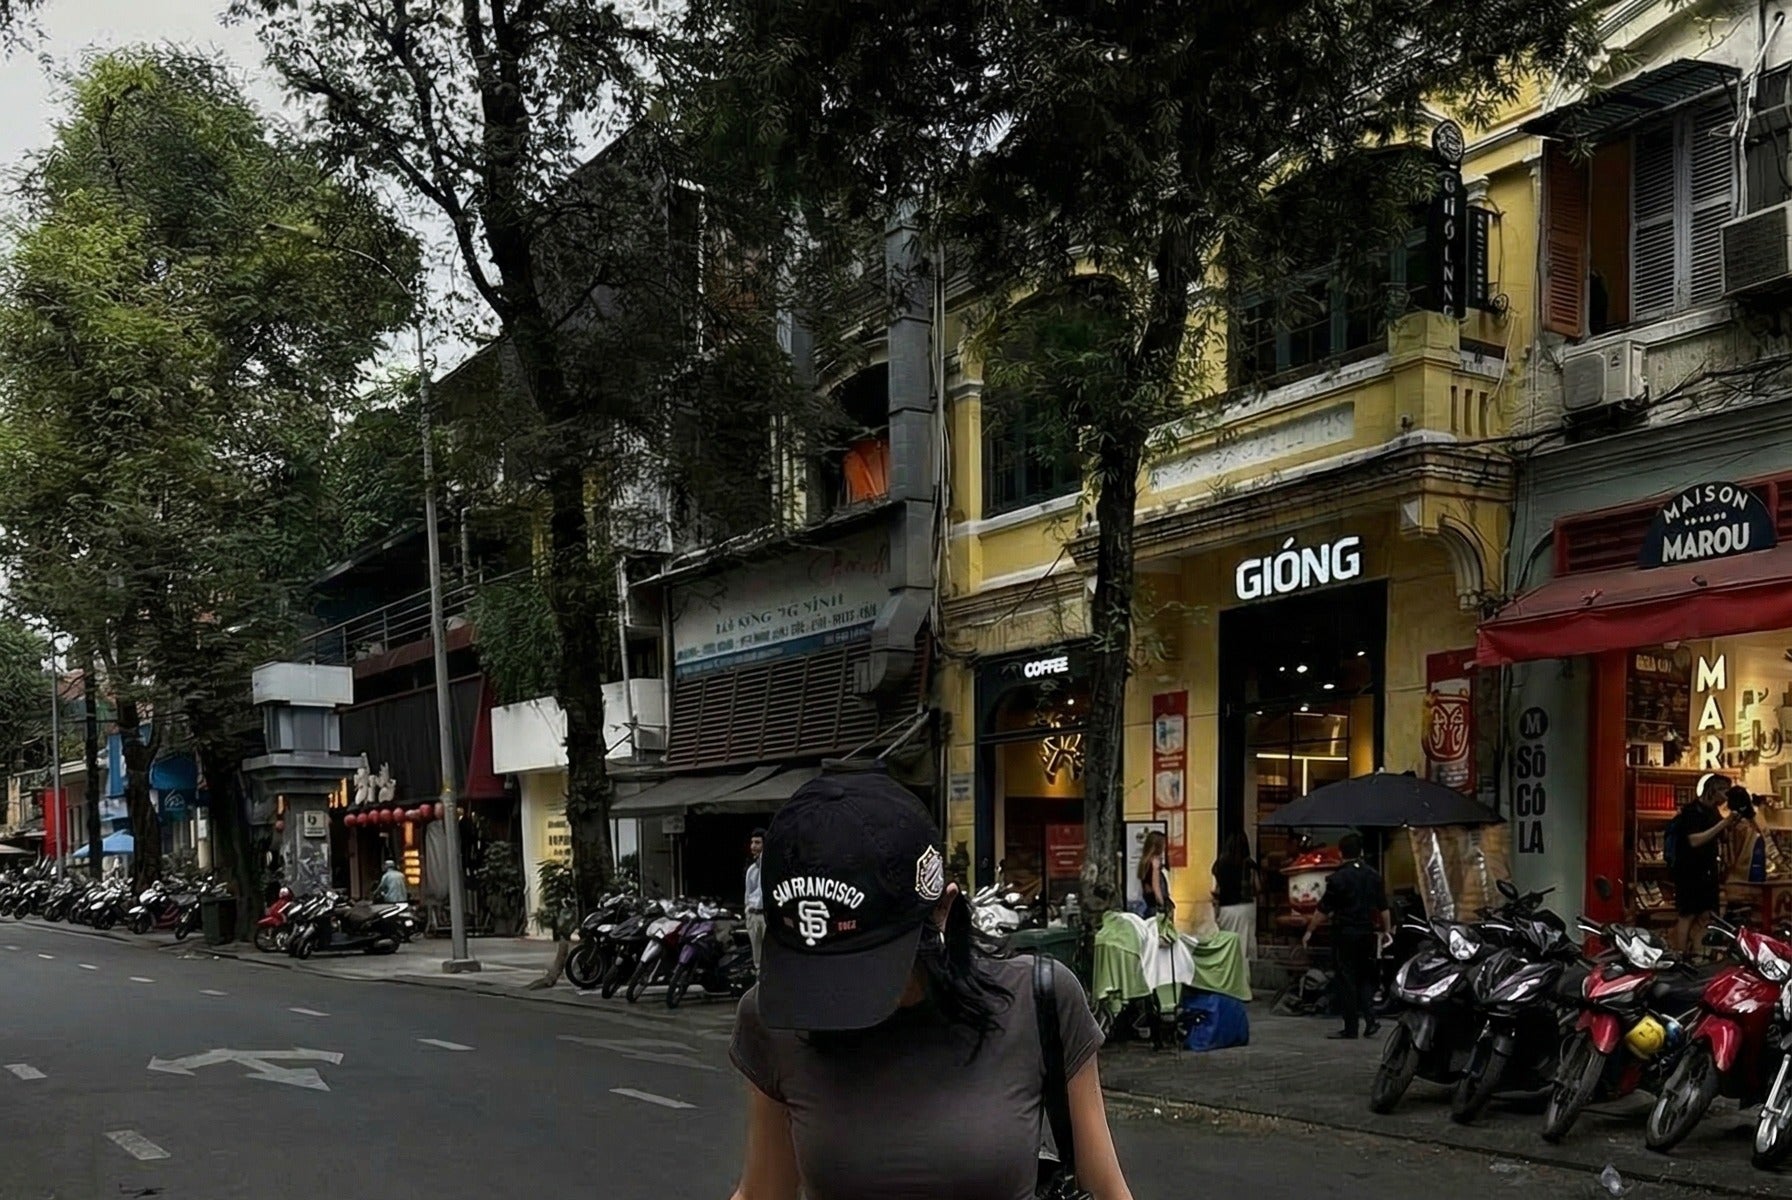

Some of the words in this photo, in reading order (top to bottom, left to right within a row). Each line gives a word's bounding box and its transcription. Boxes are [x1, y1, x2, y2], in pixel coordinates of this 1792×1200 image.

[1663, 485, 1748, 524] MAISON
[1662, 522, 1749, 562] MAROU
[1236, 536, 1360, 600] GIÓNG
[1024, 656, 1069, 678] COFFEE
[1518, 820, 1545, 854] LA
[791, 876, 865, 910] FRANCISCO
